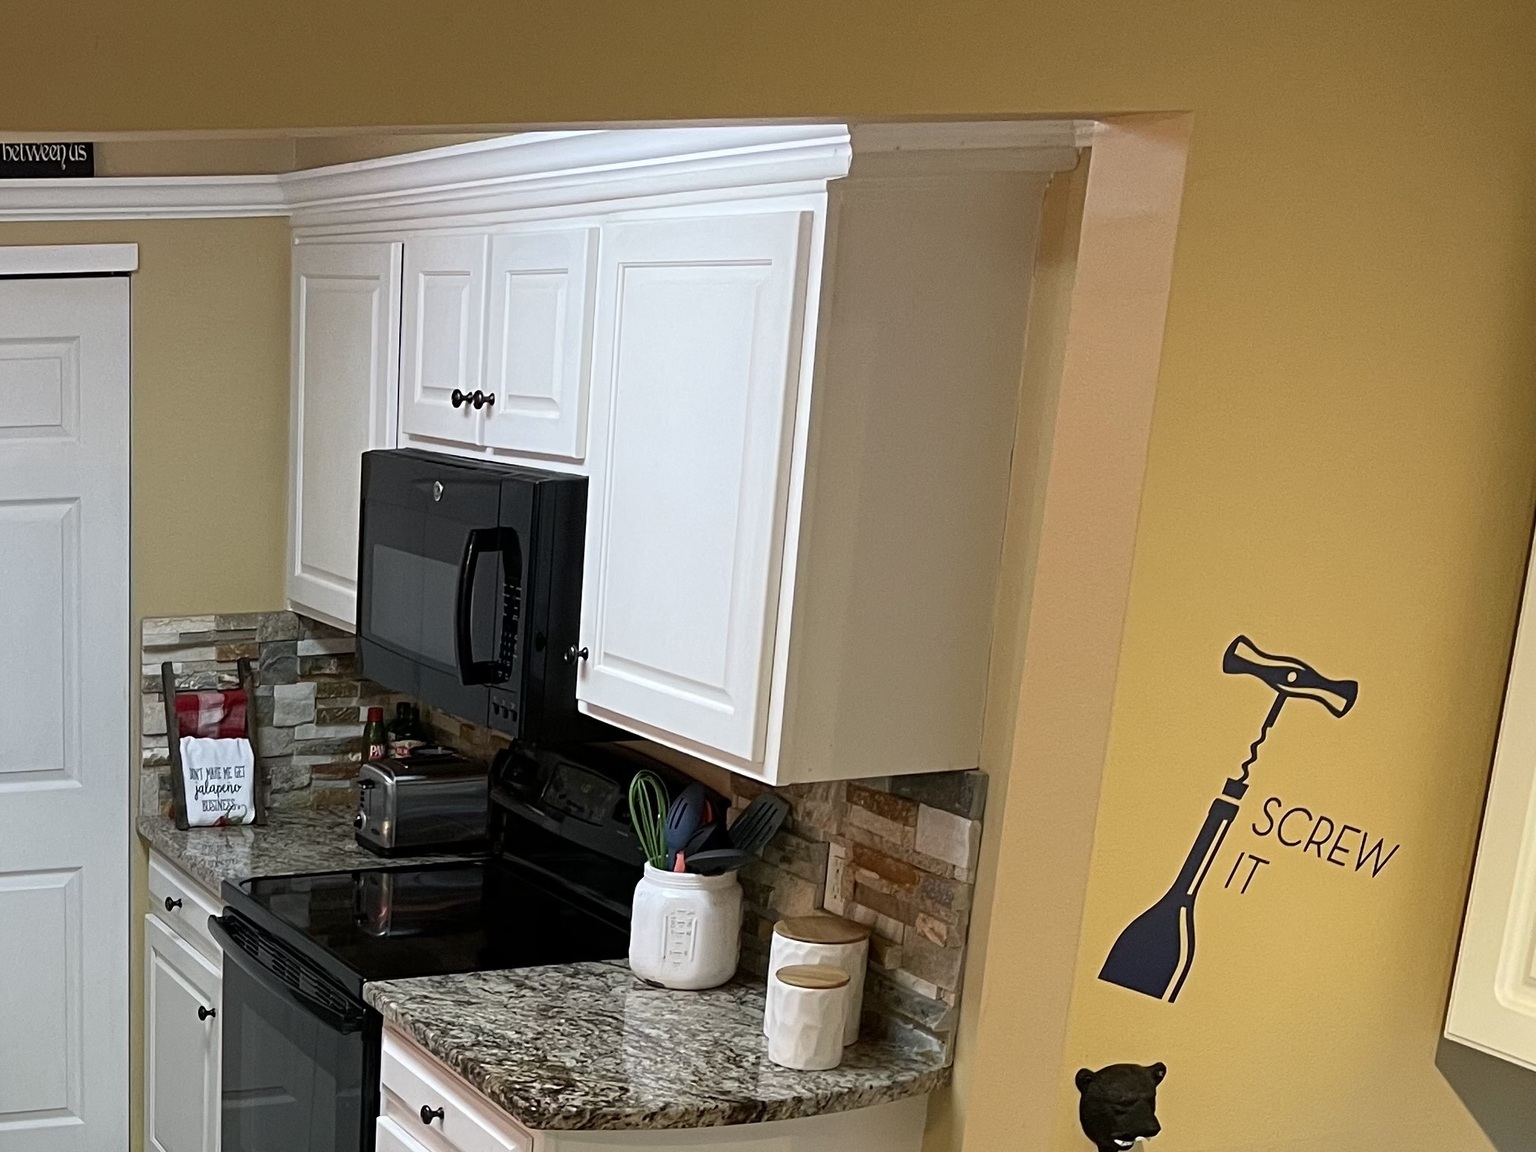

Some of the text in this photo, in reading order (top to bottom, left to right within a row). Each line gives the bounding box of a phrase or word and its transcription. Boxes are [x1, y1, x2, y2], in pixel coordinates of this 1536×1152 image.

[2, 142, 66, 170] between
[68, 142, 88, 162] us
[223, 766, 233, 780] ME
[234, 765, 245, 778] GET
[1251, 796, 1401, 879] SCREW
[1224, 851, 1270, 894] IT
